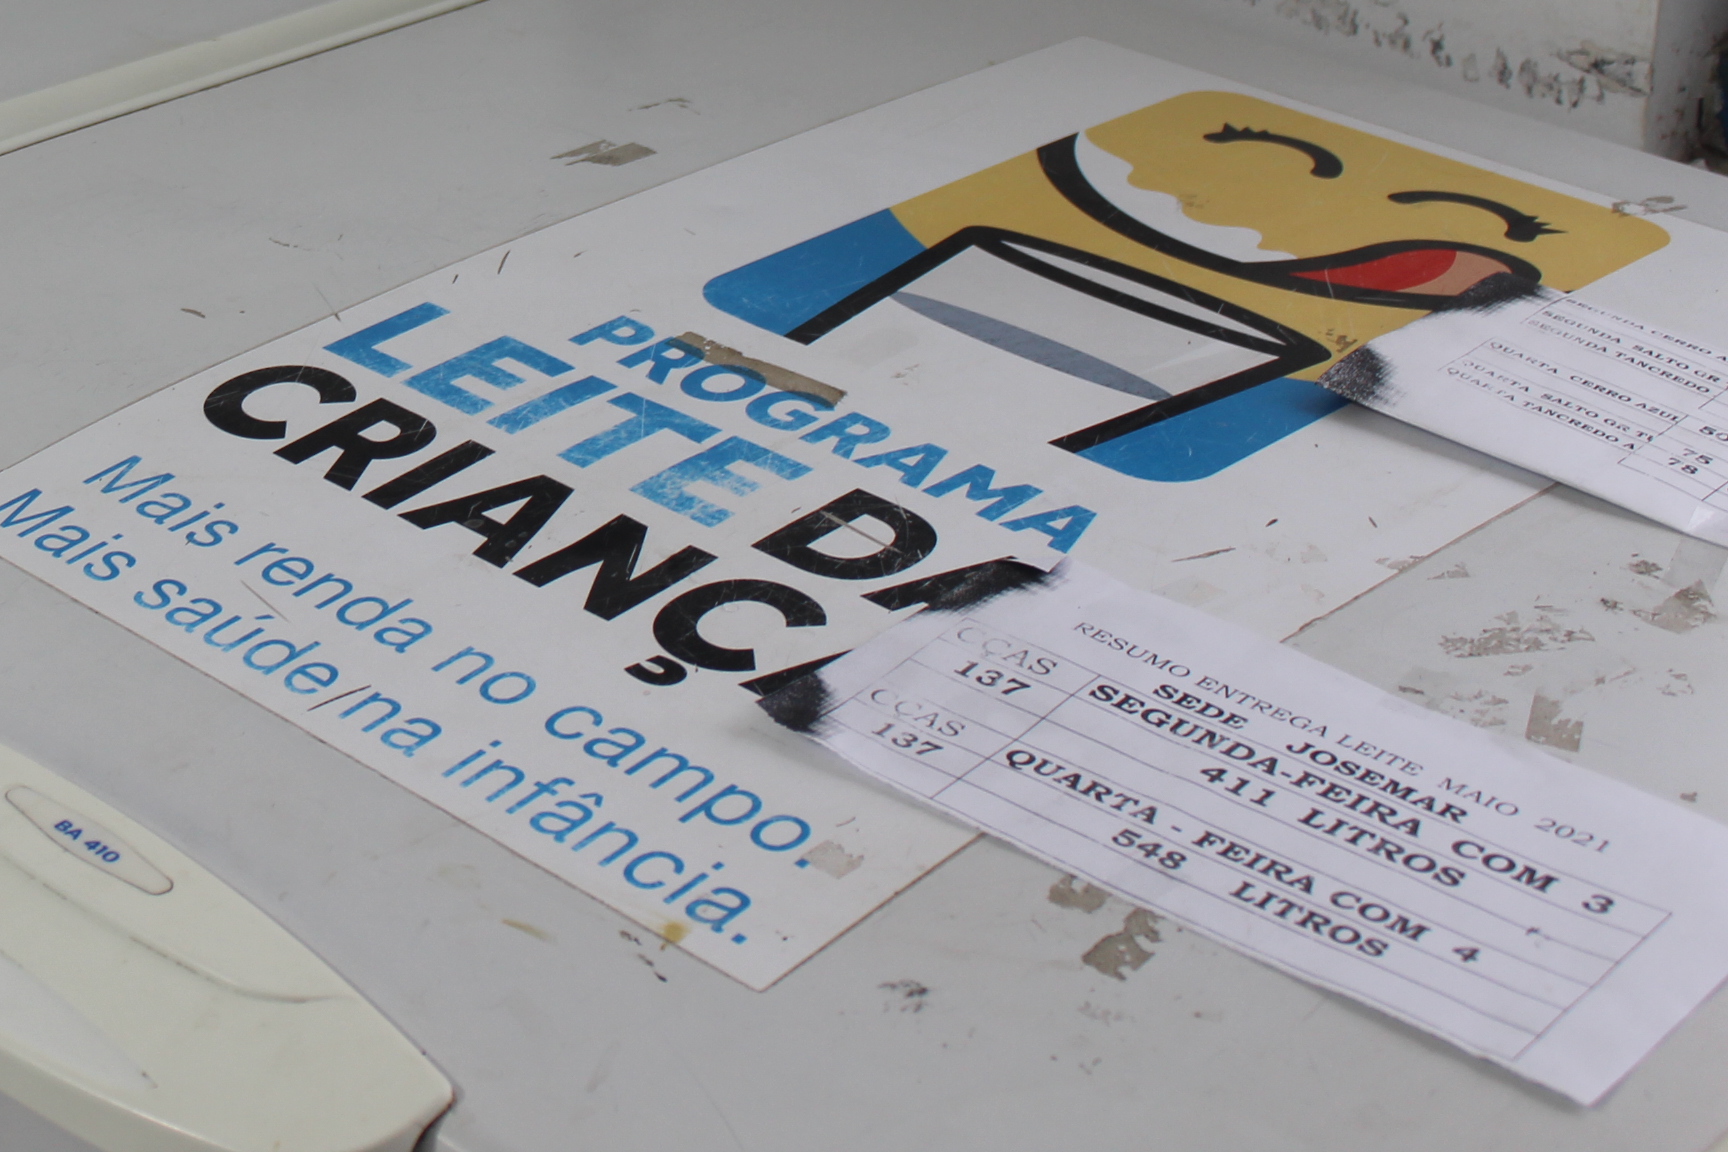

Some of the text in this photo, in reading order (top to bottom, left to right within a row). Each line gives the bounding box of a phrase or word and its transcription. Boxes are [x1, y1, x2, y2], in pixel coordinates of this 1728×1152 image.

[323, 301, 813, 528] LEITE
[568, 315, 1097, 553] PROGRAMA
[1447, 367, 1515, 401] QUARTA
[1523, 401, 1619, 442] TANCREDO
[1668, 457, 1698, 475] 78
[1490, 342, 1557, 374] QUARTA
[1570, 375, 1631, 403] CERRO
[1635, 402, 1681, 422] AZUL
[1528, 320, 1710, 393] SEGUNDA TANCREDO
[1541, 393, 1598, 418] SALTO
[1603, 418, 1630, 432] GR
[1683, 449, 1713, 465] 75
[1542, 310, 1621, 344] SEGUNDA
[1632, 344, 1689, 370] SALTO
[203, 365, 854, 696] CRIANÇ
[83, 455, 811, 870] Mais renda no campo.
[134, 578, 339, 695] saúde
[337, 691, 442, 758] na
[442, 739, 751, 945] infância.
[1073, 621, 1611, 854] RESUMO ENTREGA LEITE MAIO 2021
[1153, 683, 1248, 730] SEDE
[1285, 742, 1468, 824] JOSEMAR
[54, 819, 120, 863] BA 410
[871, 722, 1390, 959] 137 548 LITROS
[954, 660, 1615, 916] 137 SEGUNDA-FEIRA COM 3
[1005, 748, 1160, 826] QUARTA
[1192, 830, 1316, 895] FEIRA
[1328, 890, 1431, 943] COM
[1451, 945, 1480, 963] 4
[1199, 766, 1466, 888] 411 LITROS
